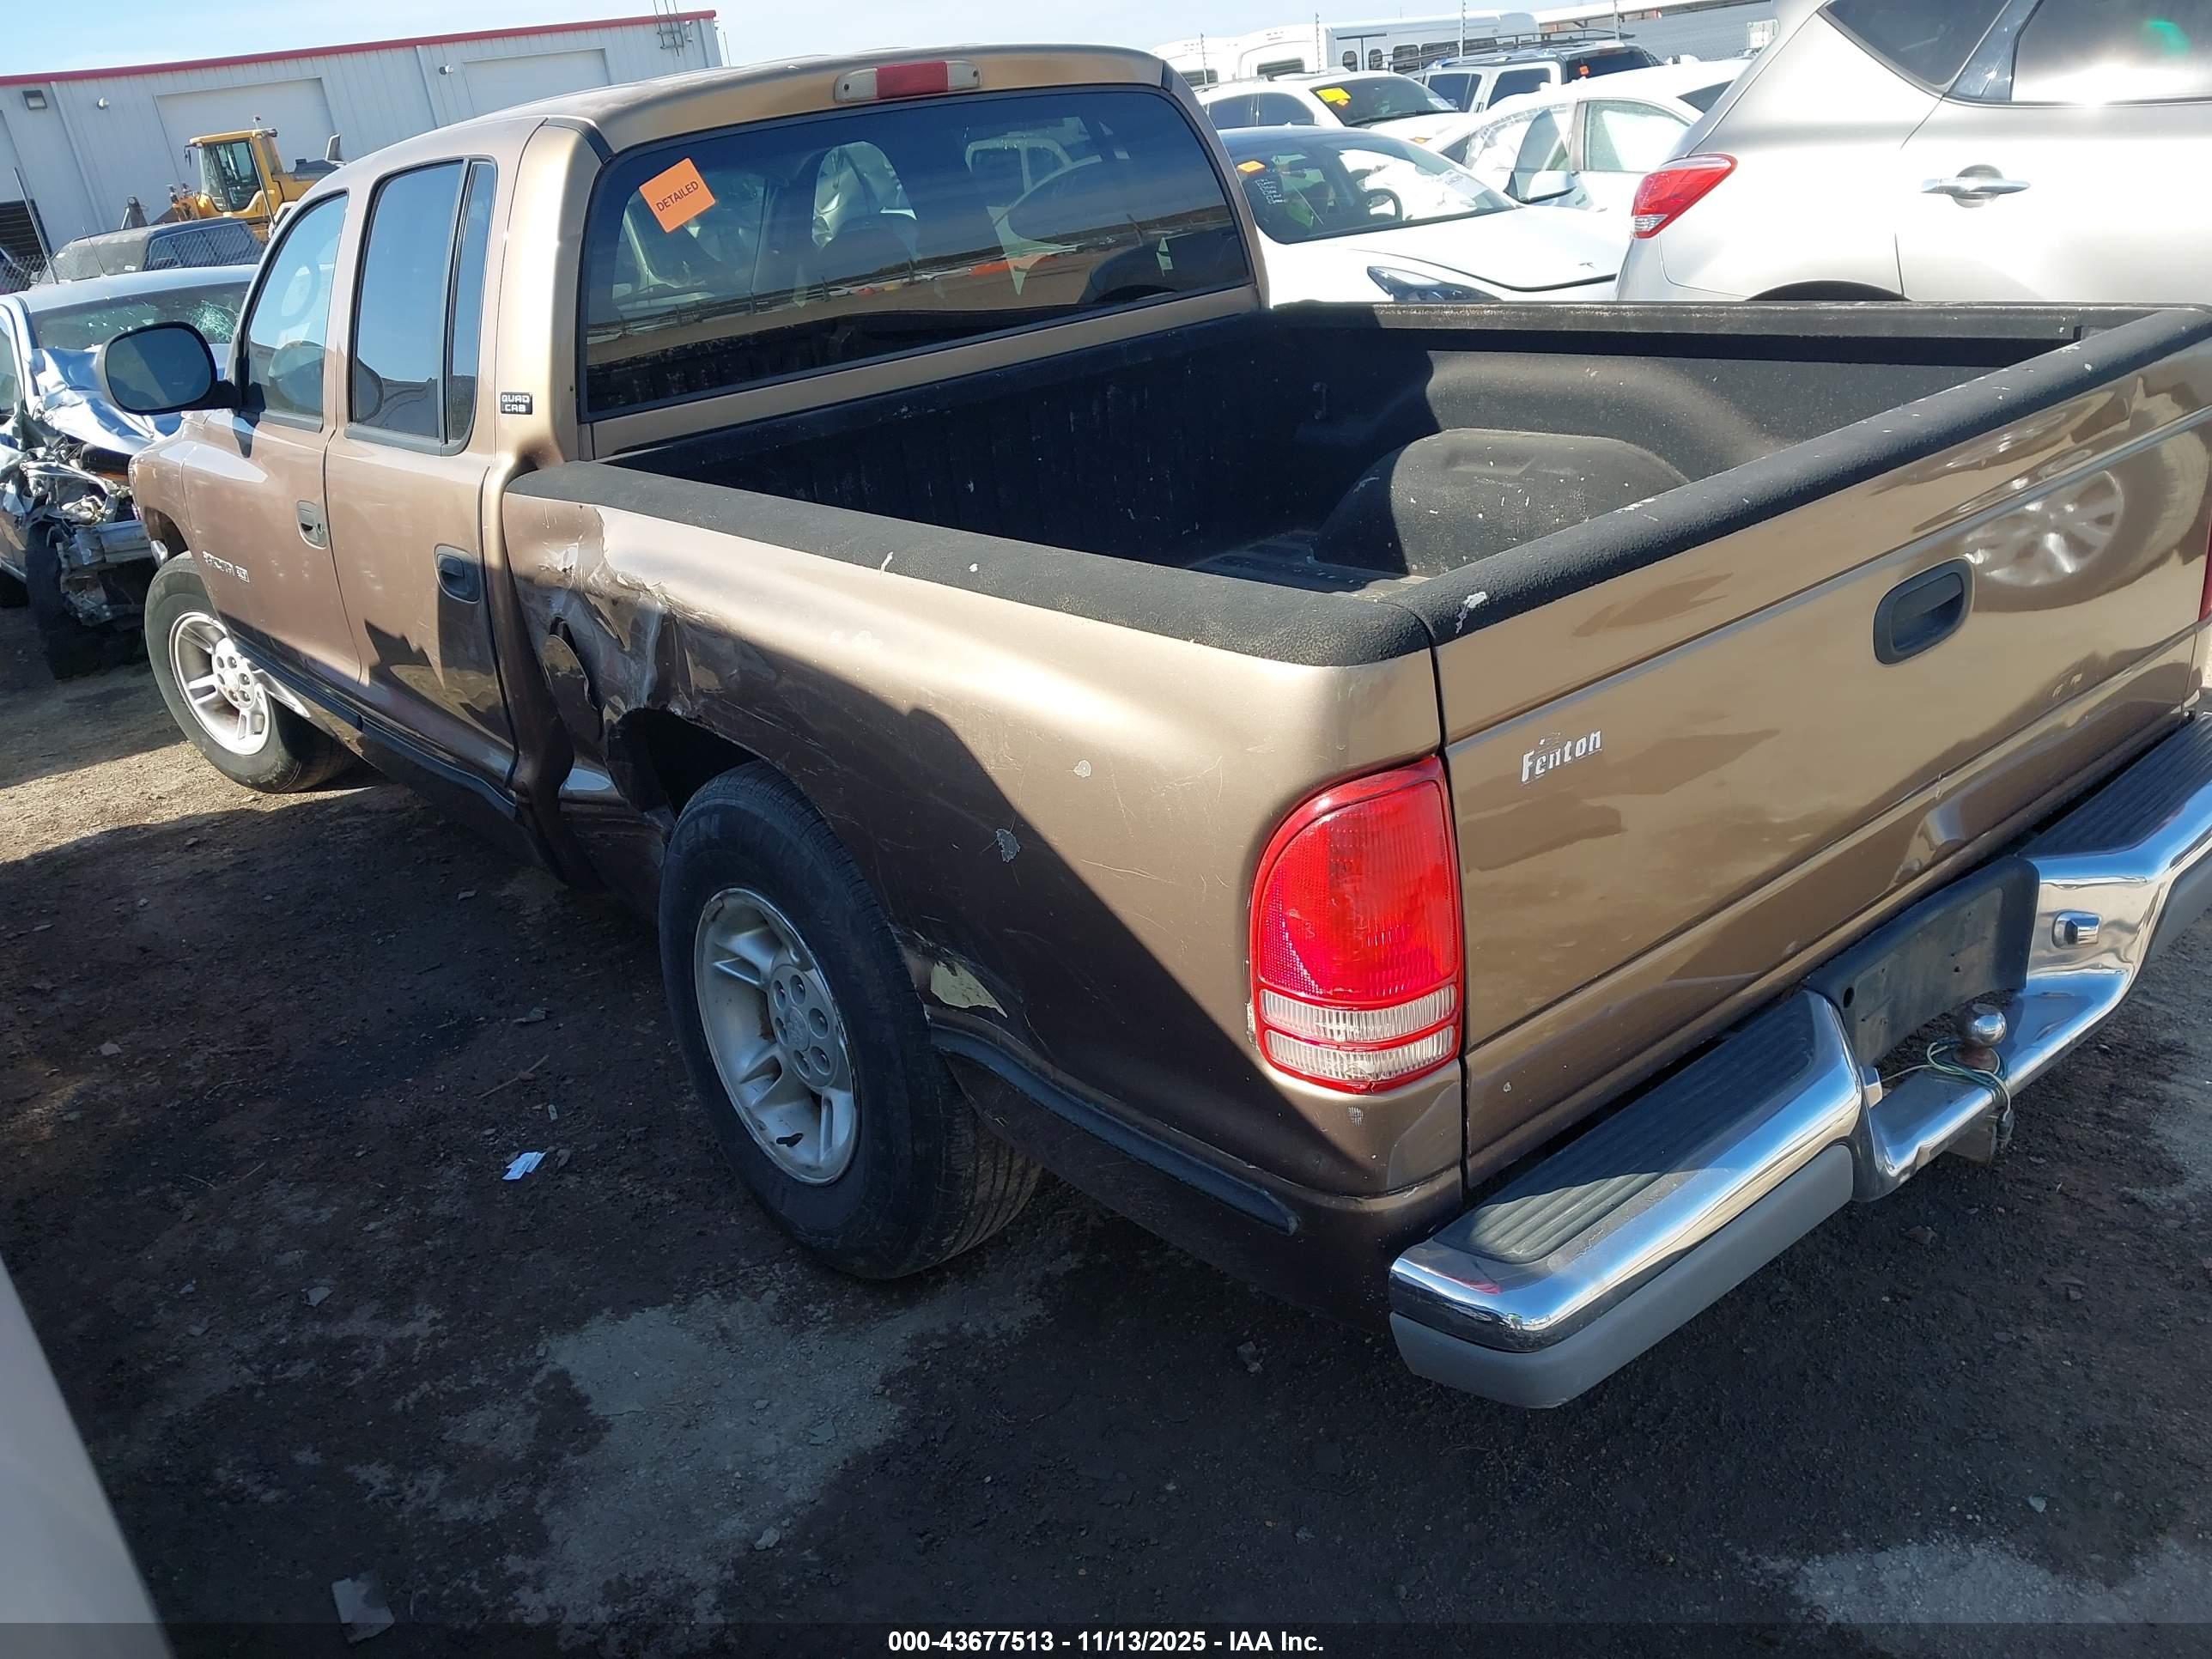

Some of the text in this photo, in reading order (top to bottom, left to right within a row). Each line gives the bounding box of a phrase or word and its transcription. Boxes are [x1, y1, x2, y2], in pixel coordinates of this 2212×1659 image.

[655, 180, 699, 212] DETAILED
[501, 395, 530, 404] QUAD
[1521, 730, 1601, 782] Fenton
